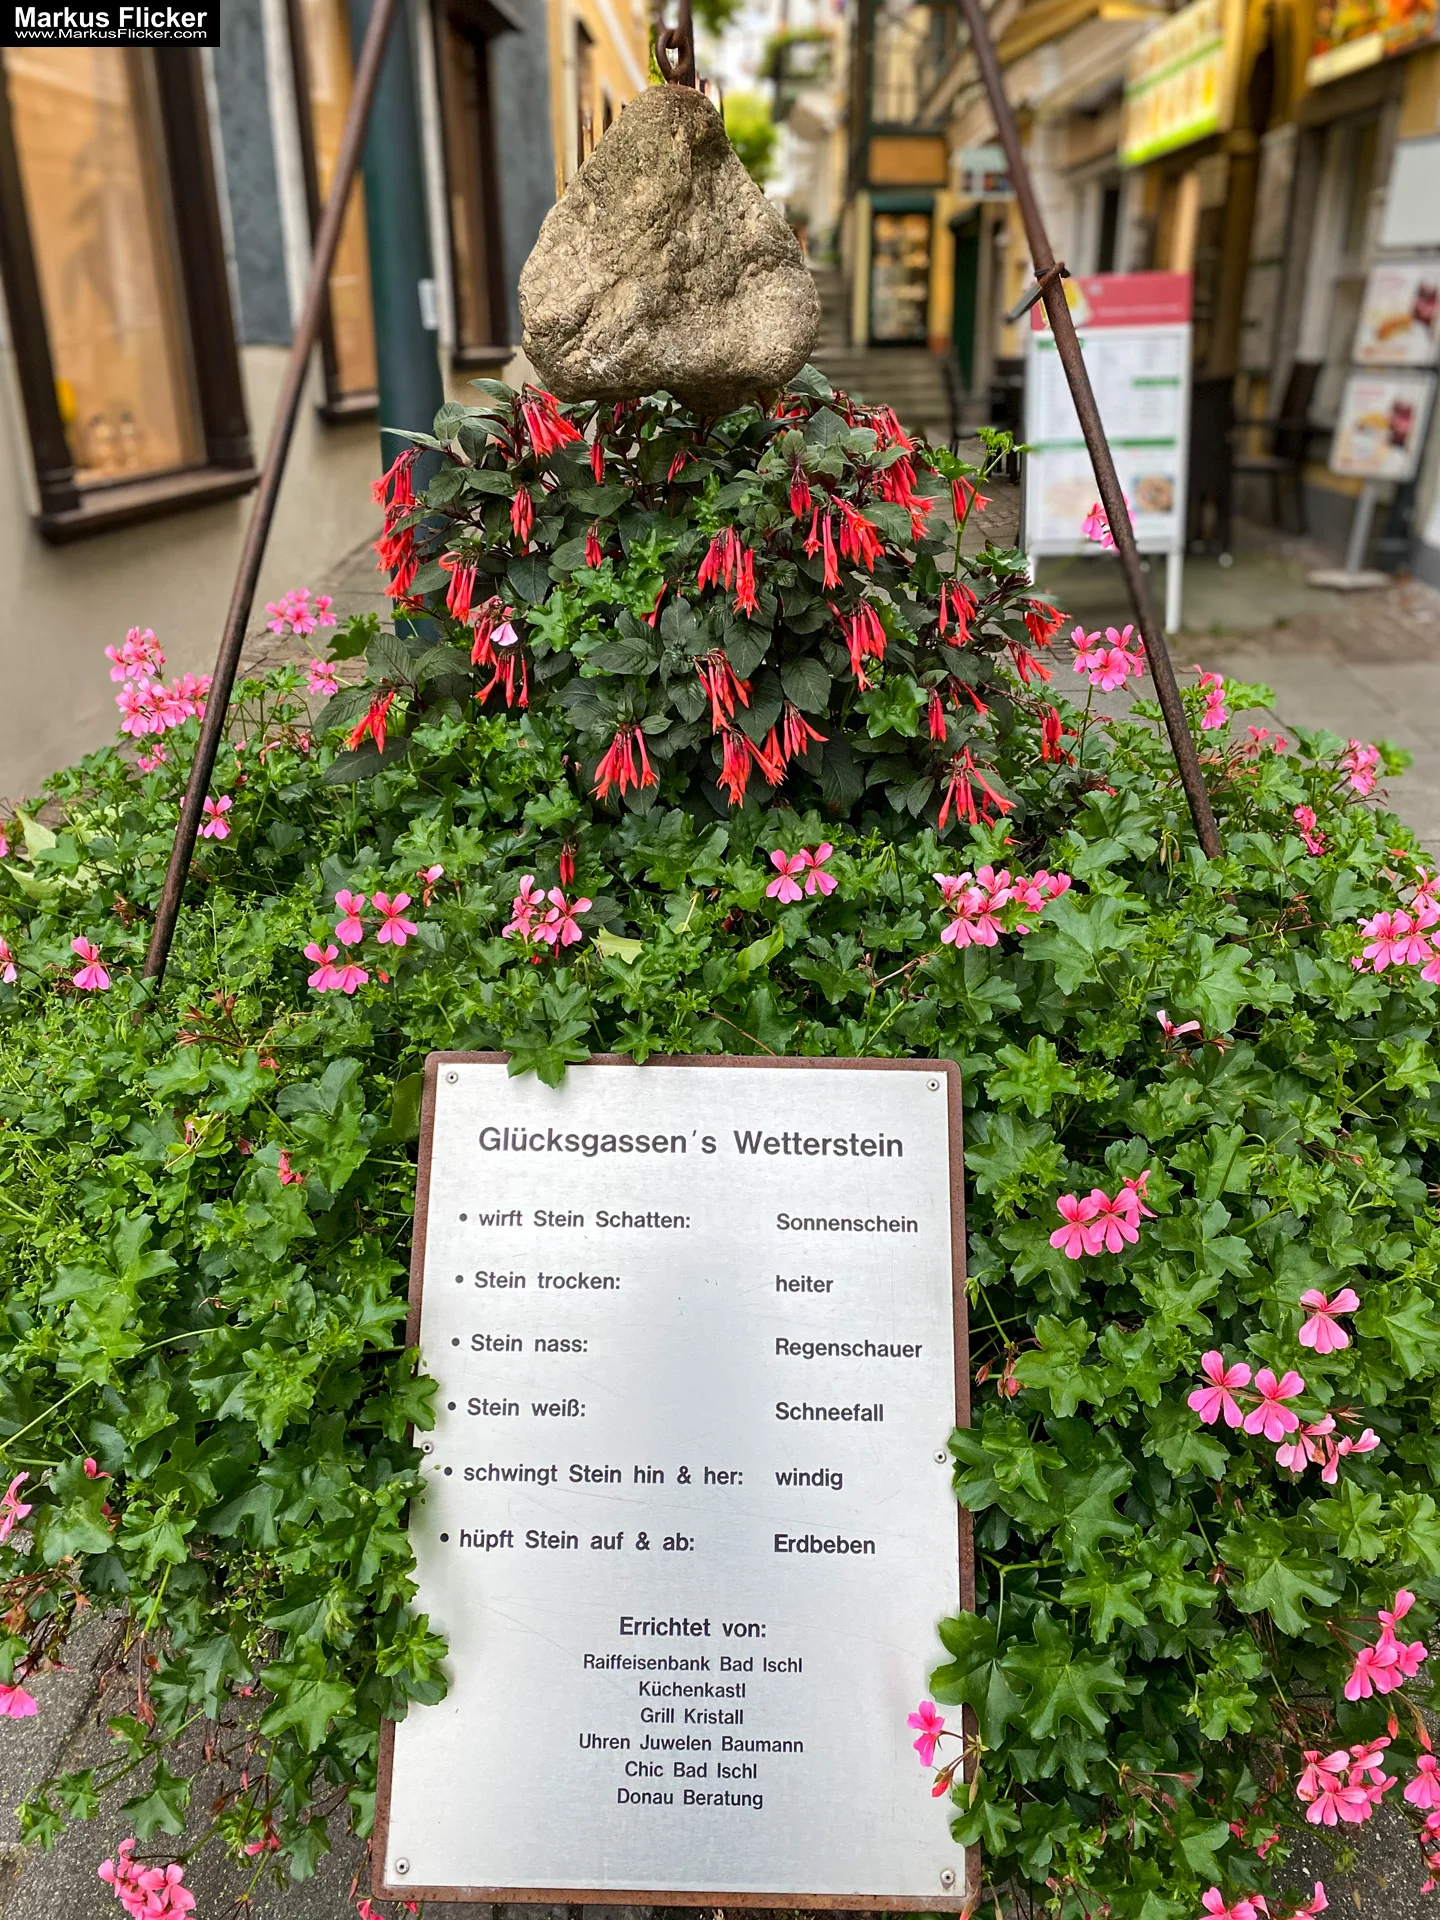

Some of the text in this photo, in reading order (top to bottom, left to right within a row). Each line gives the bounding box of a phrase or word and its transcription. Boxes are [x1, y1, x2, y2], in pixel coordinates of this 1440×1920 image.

[734, 1131, 902, 1156] Wetterstein
[480, 1210, 917, 1232] wirft Stein Schatten: Sonnenschein
[475, 1271, 833, 1292] Stein trocken: heiter
[472, 1334, 922, 1359] Stein nass: Regenschauer
[468, 1398, 883, 1421] Stein weiß: Schneefall
[464, 1464, 842, 1490] schwingt Stein hin & her: windig
[460, 1529, 875, 1554] hüpft Stein auf & ab: Erdbeben
[620, 1617, 765, 1637] Errichtet von:
[584, 1654, 802, 1672] Raiffeisenbank Bad Ischl
[640, 1681, 745, 1698] Küchenkastl
[641, 1708, 743, 1724] Grill Kristall
[580, 1733, 803, 1752] Uhren Juwelen Baumann
[625, 1761, 756, 1779] Chic Bad Ischl
[618, 1788, 762, 1809] Donau Beratung
